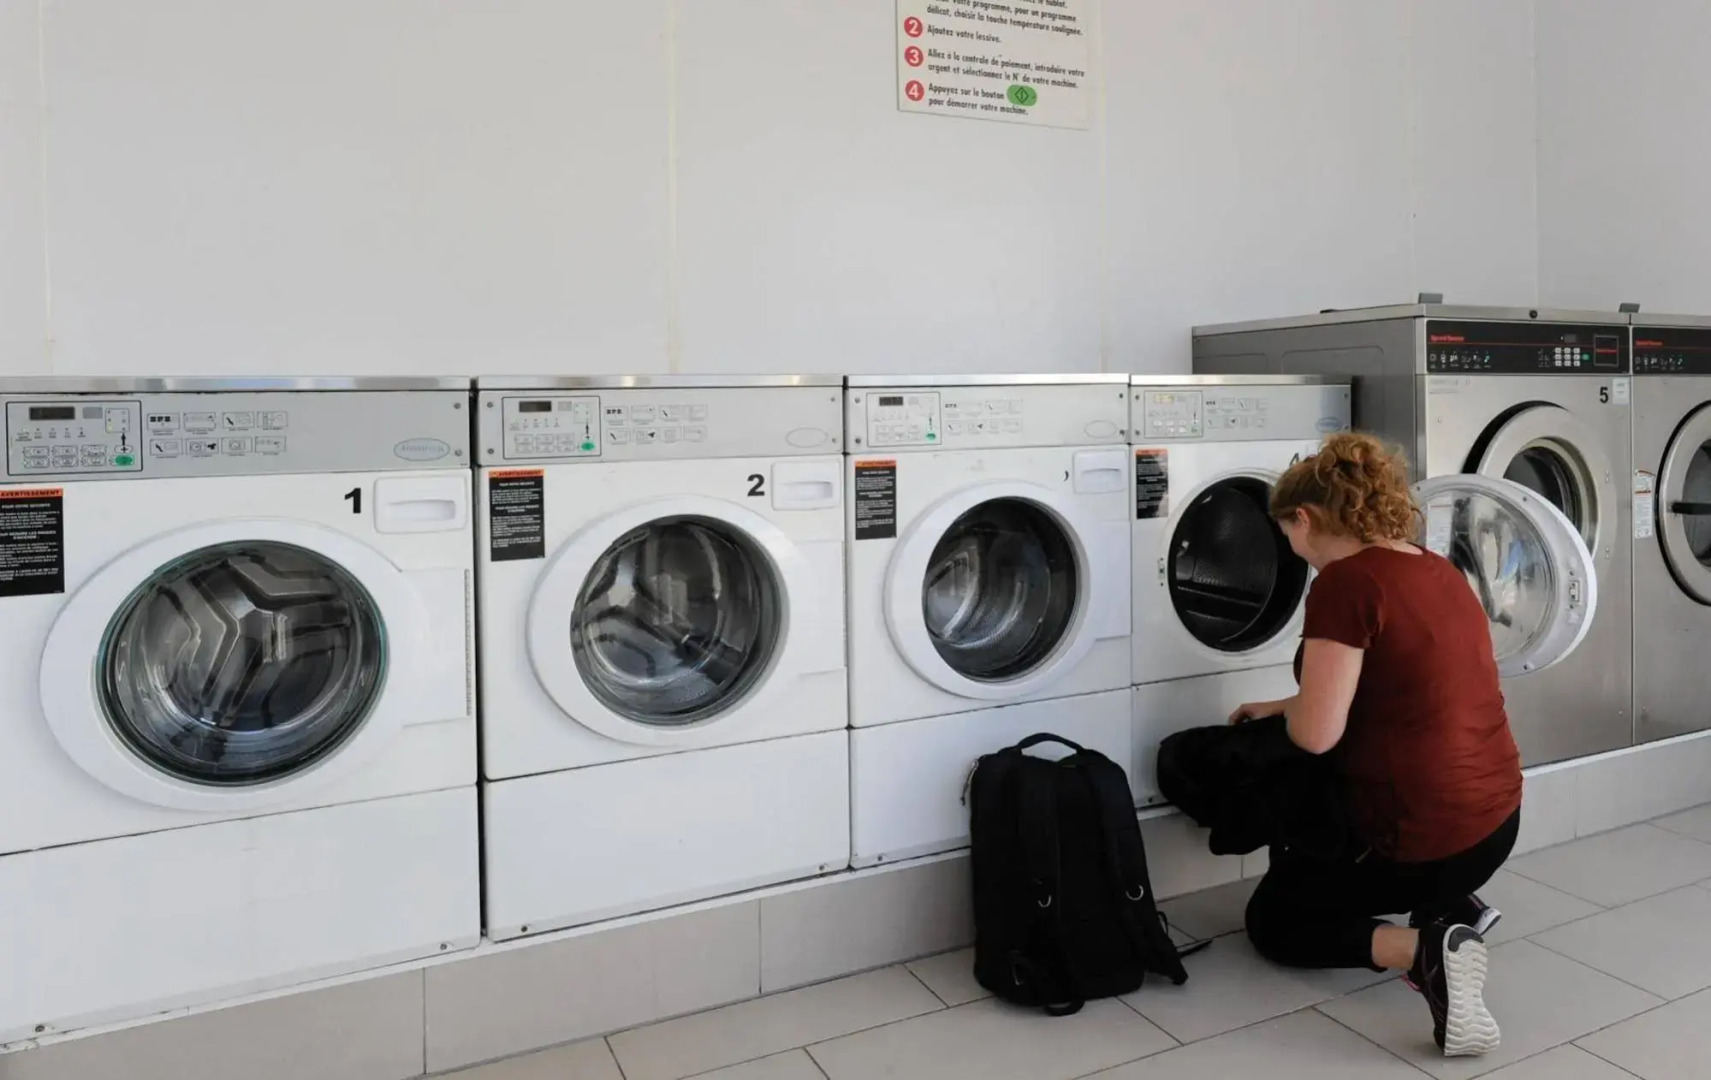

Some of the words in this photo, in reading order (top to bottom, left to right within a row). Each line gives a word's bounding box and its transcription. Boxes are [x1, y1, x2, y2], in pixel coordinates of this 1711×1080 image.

[954, 8, 976, 20] choisir
[977, 12, 985, 21] la
[986, 14, 1008, 24] touche
[972, 1, 1012, 14] programme,
[1014, 7, 1029, 16] pour
[1041, 11, 1077, 22] programme
[909, 20, 919, 35] 2
[927, 24, 953, 37] Ajoutez
[955, 31, 974, 40] votre
[976, 31, 1001, 43] lessive.
[909, 49, 919, 65] 3
[928, 48, 945, 59] Allez
[954, 51, 960, 61] la
[962, 54, 989, 65] centrale
[991, 57, 999, 66] de
[1001, 59, 1033, 71] paiement,
[1034, 63, 1066, 75] introduire
[1068, 68, 1085, 77] votre
[928, 64, 950, 74] argent
[1004, 71, 1011, 81] le
[1022, 74, 1030, 83] de
[1032, 77, 1050, 85] votre
[1051, 79, 1079, 89] machine.
[908, 83, 919, 99] 4
[928, 83, 958, 96] Appuyez
[960, 88, 971, 96] sur
[973, 88, 979, 97] le
[981, 89, 1004, 99] bouton
[928, 98, 944, 107] pour
[980, 104, 998, 112] votre
[1000, 105, 1029, 115] machine.
[1599, 386, 1609, 404] 5
[747, 473, 765, 497] 2
[344, 487, 361, 514] 1
